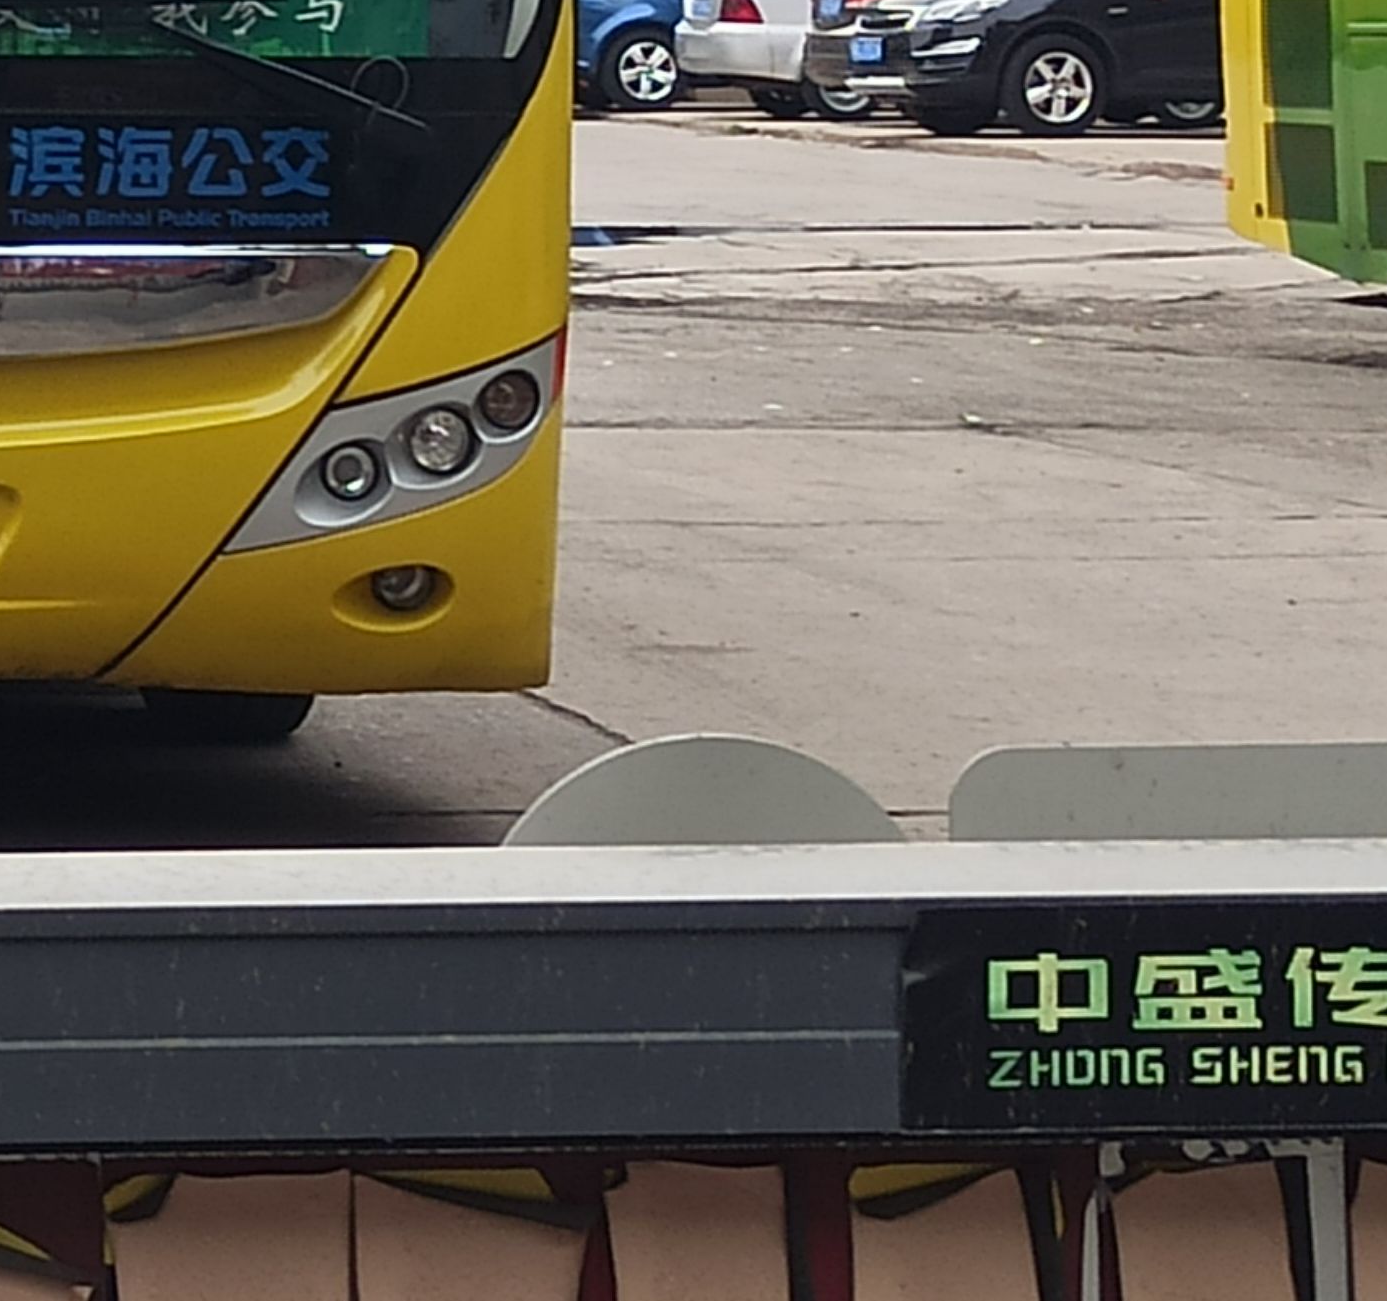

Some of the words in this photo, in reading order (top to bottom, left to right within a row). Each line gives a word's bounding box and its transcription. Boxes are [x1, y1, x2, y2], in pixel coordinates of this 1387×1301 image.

[8, 126, 331, 197] 滨海公交
[9, 208, 80, 231] Tianjin
[85, 208, 152, 227] Binhai
[157, 208, 222, 227] Public
[227, 208, 330, 231] Transport
[987, 946, 1387, 1033] 中盛传
[987, 1047, 1166, 1088] ZHONG
[1190, 1045, 1364, 1085] SHENG
